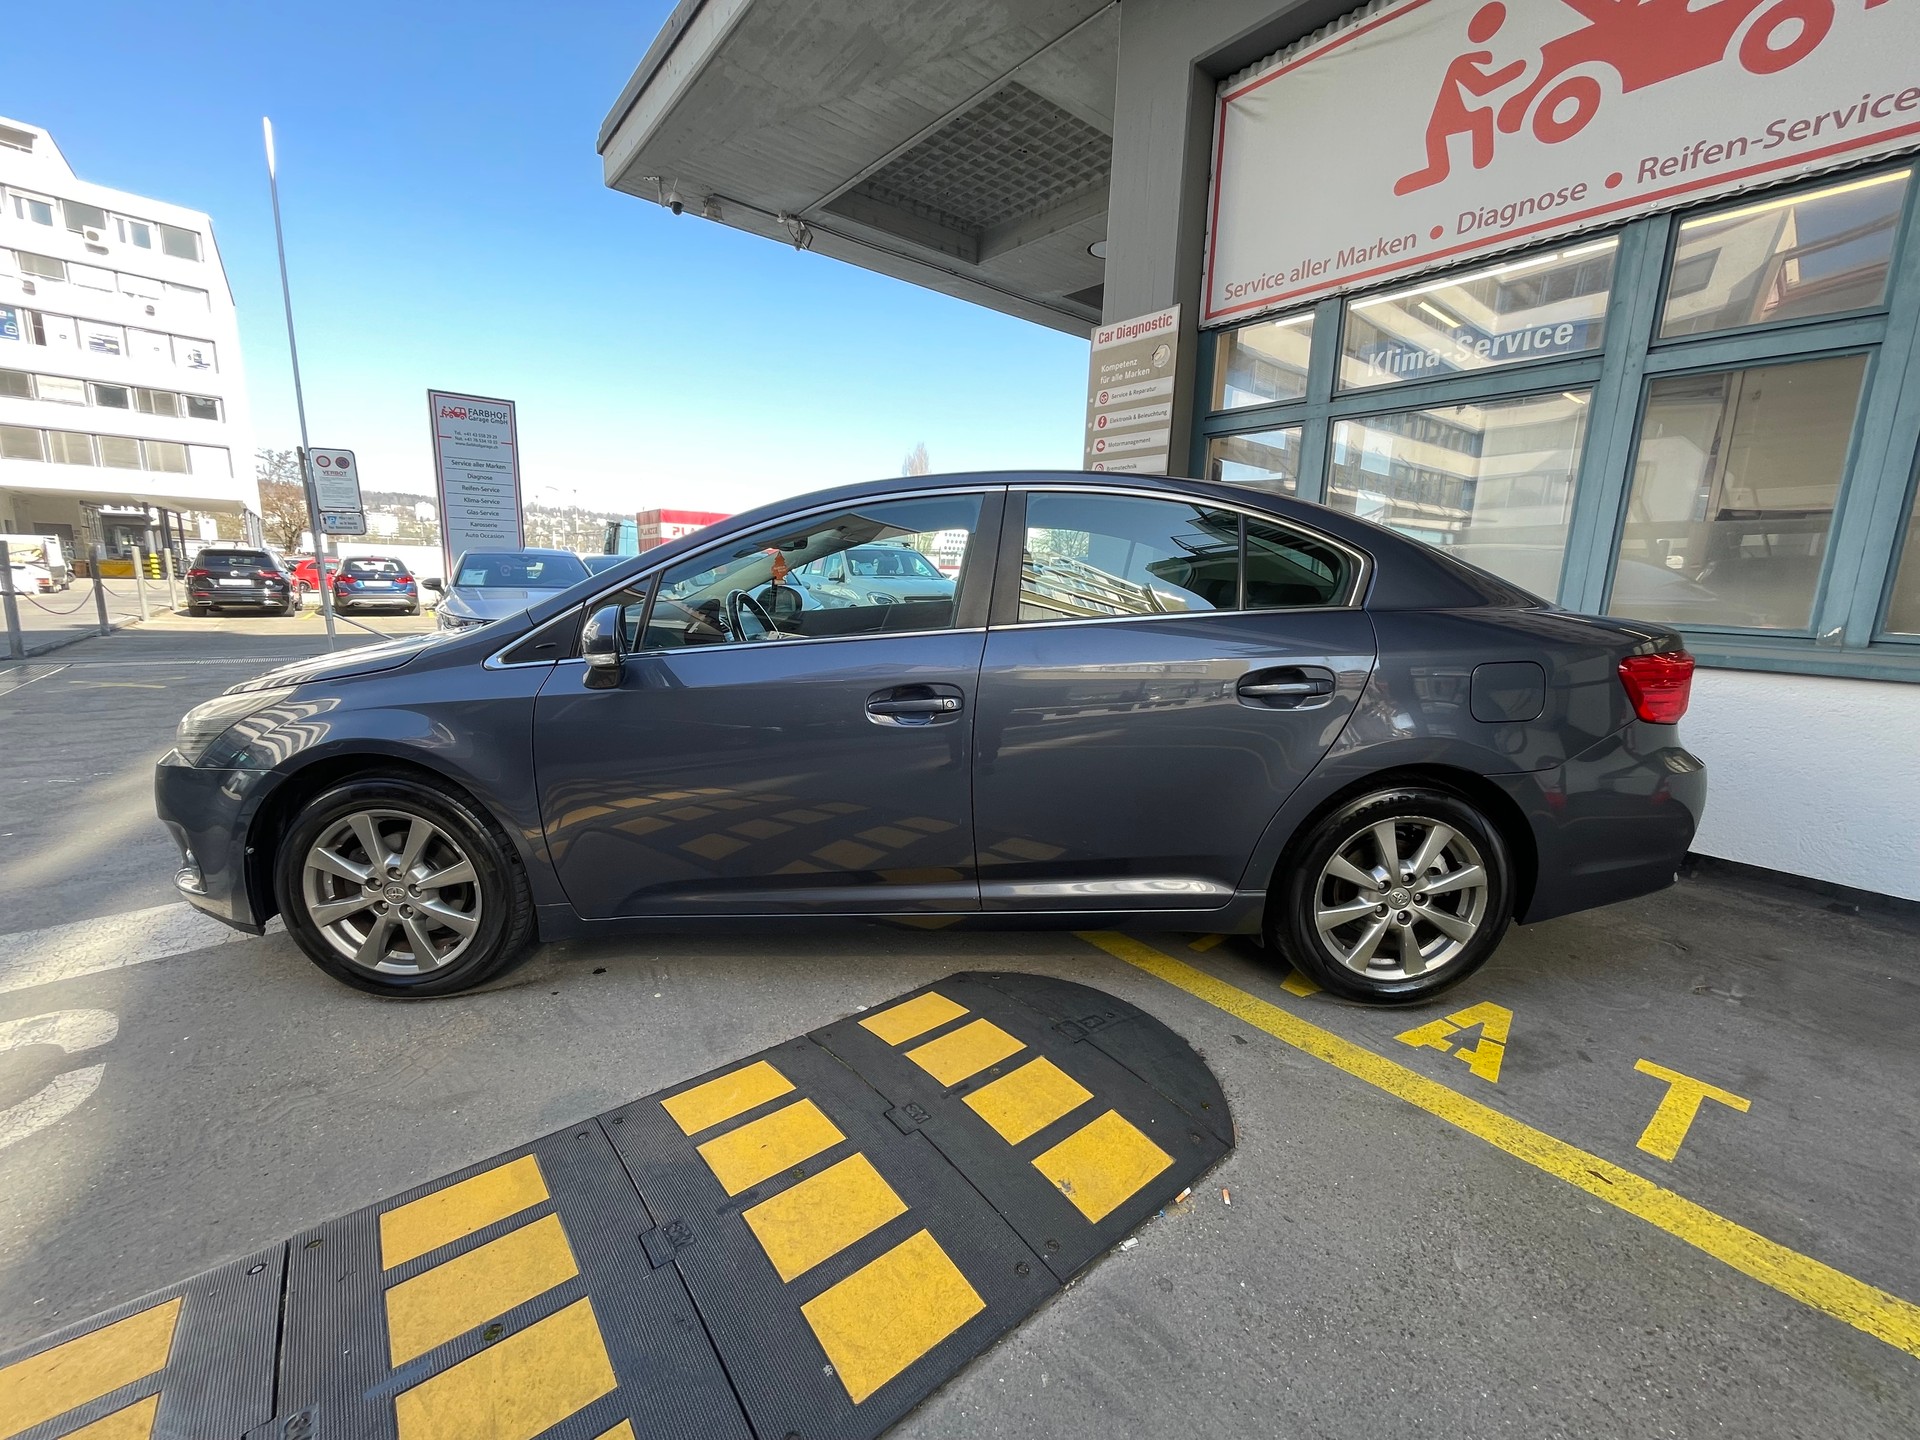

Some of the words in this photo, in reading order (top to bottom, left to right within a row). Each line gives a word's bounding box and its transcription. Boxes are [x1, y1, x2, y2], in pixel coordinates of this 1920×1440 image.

[1223, 269, 1285, 301] Service
[1289, 257, 1331, 283] aller
[1335, 232, 1417, 270] Marken
[1456, 181, 1588, 236] Diagnose
[1637, 86, 1920, 185] Reifen-Service
[1098, 330, 1115, 344] Car
[1116, 313, 1173, 341] Diagnostic
[1367, 323, 1574, 377] Klima-Service
[1101, 358, 1138, 373] Kompetenz
[1100, 375, 1110, 385] für
[1111, 373, 1123, 383] alle
[1124, 368, 1150, 380] Marken
[1111, 391, 1128, 400] Service
[1133, 386, 1157, 395] Reparatur
[468, 408, 508, 420] FARBHOF
[468, 415, 490, 424] Garage
[1109, 415, 1132, 424] Elektronik
[1137, 410, 1168, 420] Beleuchtung
[1108, 437, 1151, 448] Motormanagement
[467, 473, 493, 481] Diagnose
[461, 485, 500, 493] Reifen-Service
[463, 497, 501, 505] Klima-Service
[466, 509, 500, 517] Glas-Service
